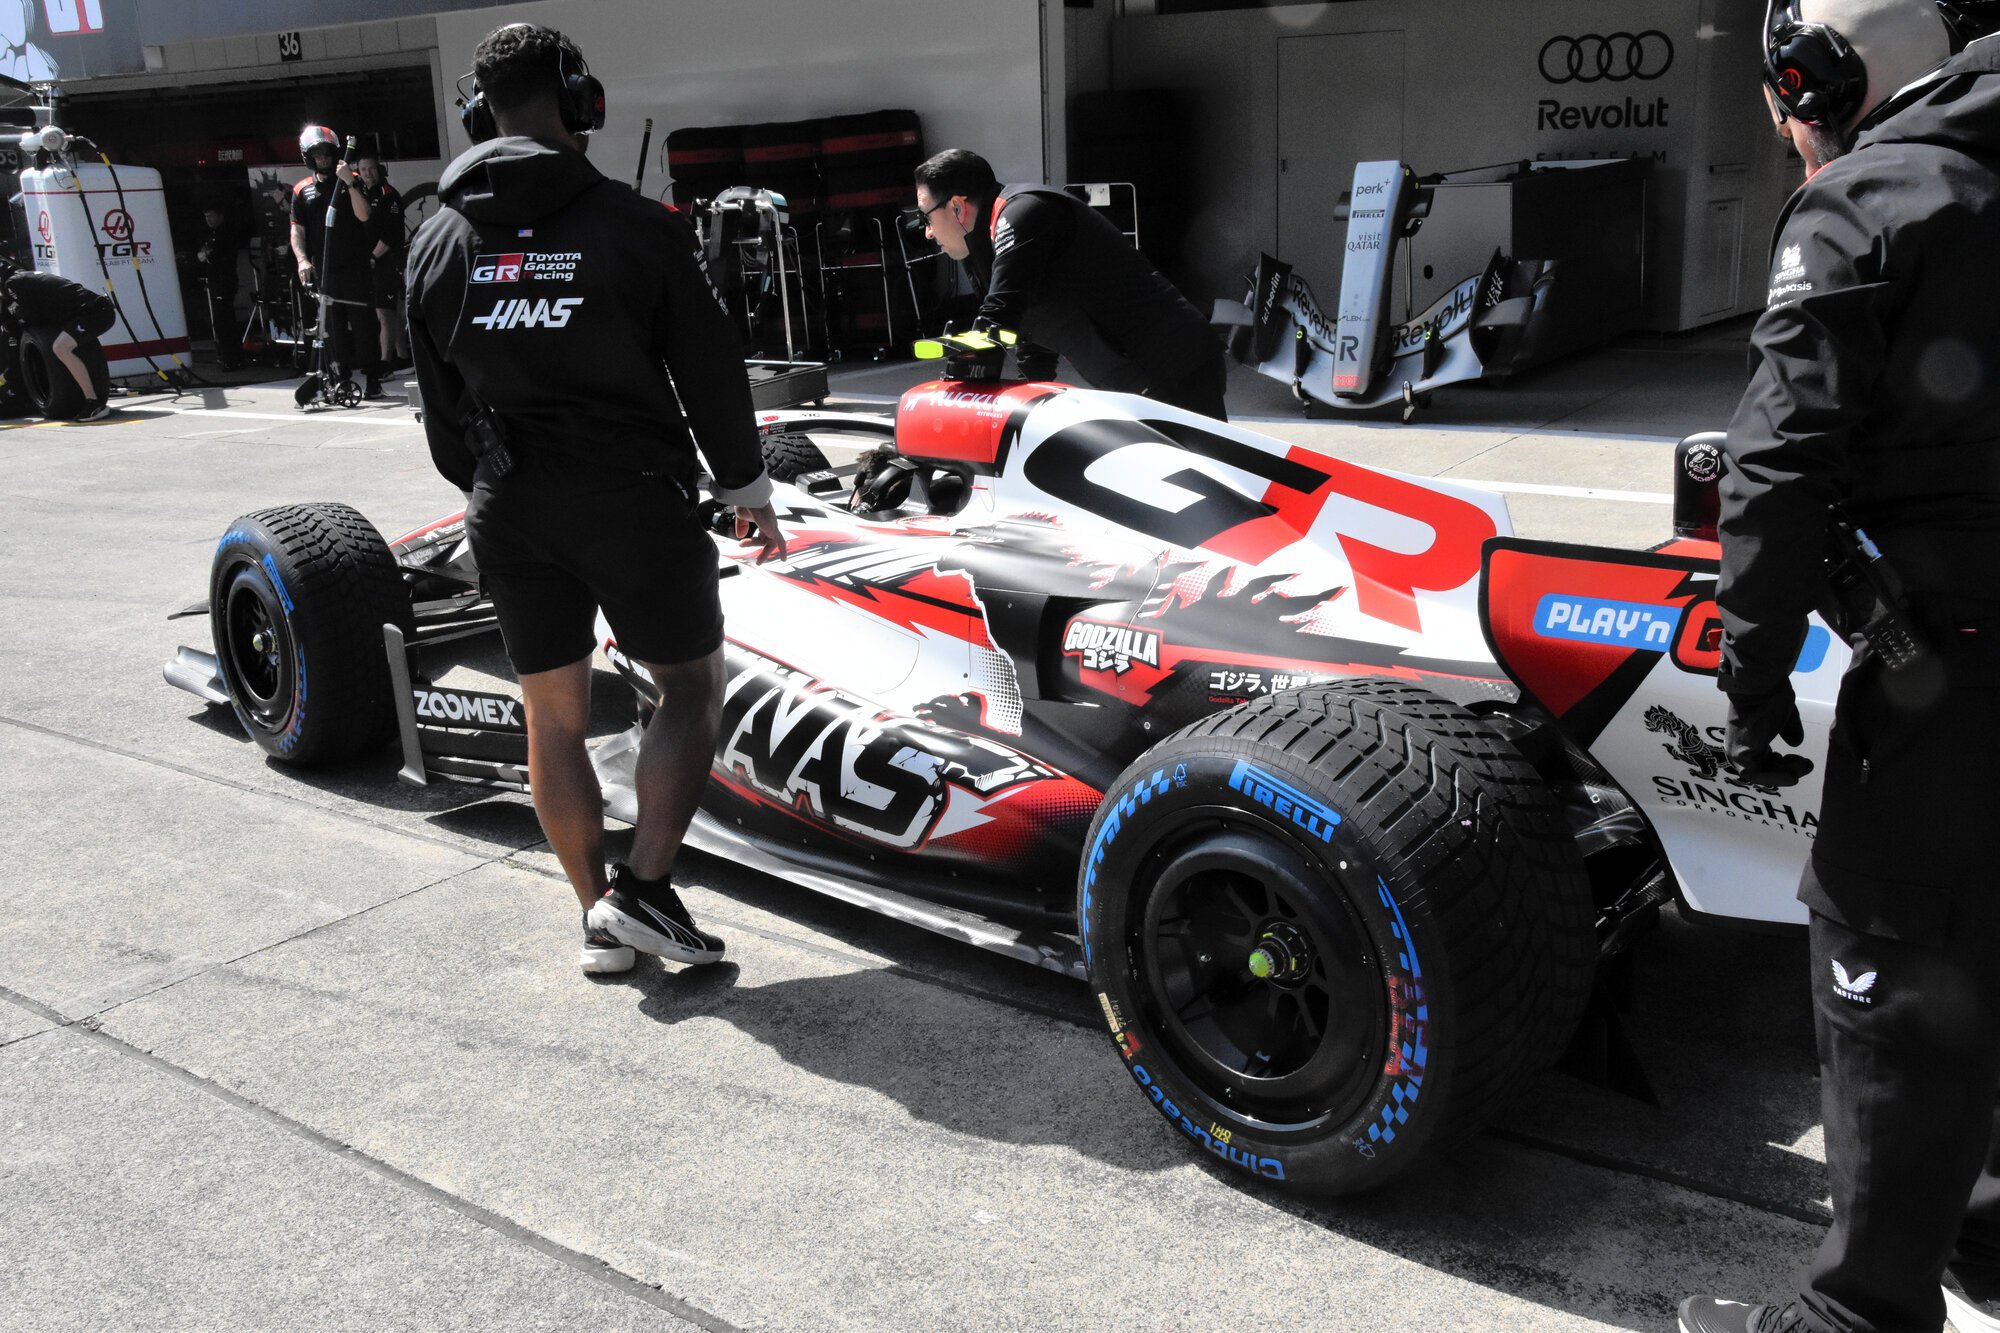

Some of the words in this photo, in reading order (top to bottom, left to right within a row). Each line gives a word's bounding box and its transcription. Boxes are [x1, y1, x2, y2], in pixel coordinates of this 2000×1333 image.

[280, 33, 299, 56] 36
[1538, 97, 1669, 130] Revolut
[1352, 209, 1385, 219] PIRELLI
[1347, 241, 1380, 252] QATAR
[1359, 232, 1381, 241] visit
[524, 262, 576, 271] GAZOO
[526, 253, 582, 261] TOYOTA
[473, 264, 519, 281] GR
[523, 271, 574, 282] Racing
[1266, 272, 1281, 307] berlin
[472, 297, 584, 330] HAAS
[1339, 335, 1359, 362] R
[1687, 443, 1719, 457] GENE'S
[1023, 418, 1497, 635] GR
[1064, 621, 1158, 667] GODZILLA
[1083, 646, 1130, 674] ゴジラ
[413, 690, 521, 727] ZOOMEX
[1229, 759, 1342, 844] PIRELLI
[1652, 775, 1821, 829] SINGHA
[1660, 795, 1817, 841] CORPORATIO
[1132, 1064, 1286, 1181] Cinturato
